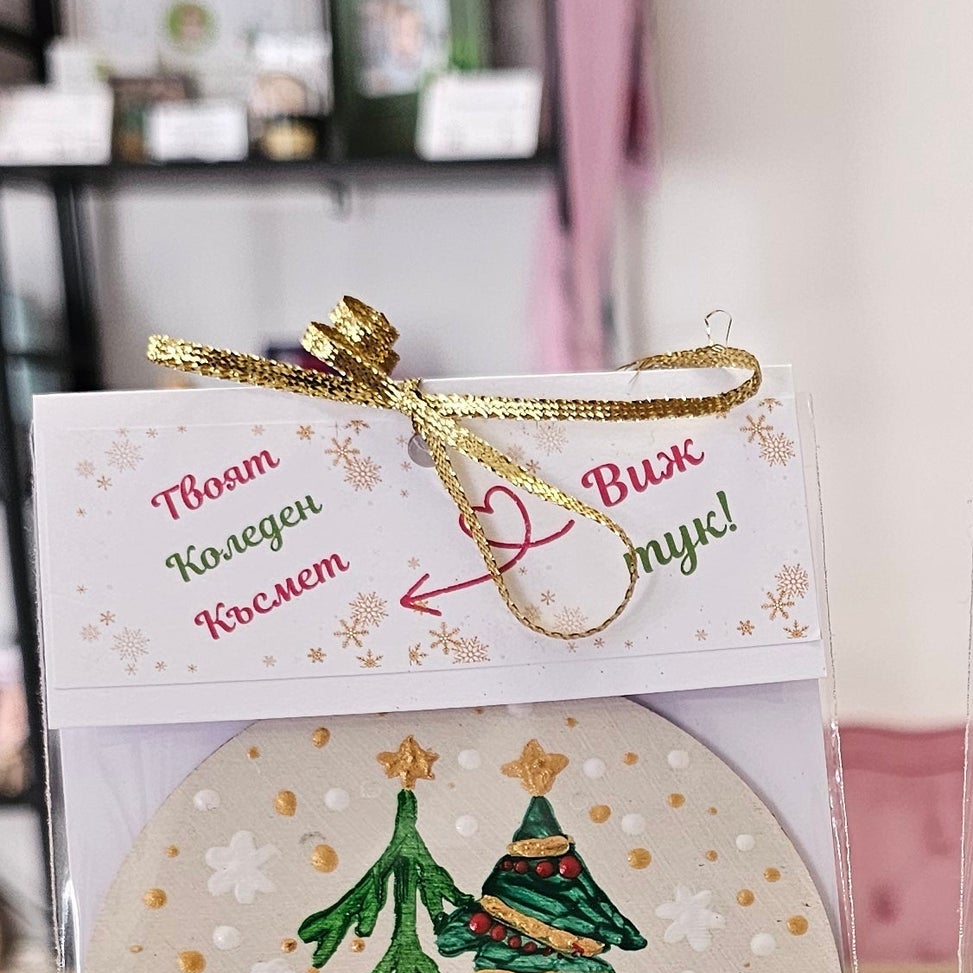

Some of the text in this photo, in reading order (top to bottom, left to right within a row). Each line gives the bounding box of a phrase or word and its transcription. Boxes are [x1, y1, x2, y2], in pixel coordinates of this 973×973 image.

[150, 448, 280, 521] Твоят
[581, 438, 705, 508] Виж
[165, 493, 323, 584] Коледен
[622, 490, 738, 576] тук!
[193, 550, 351, 641] Късмет
